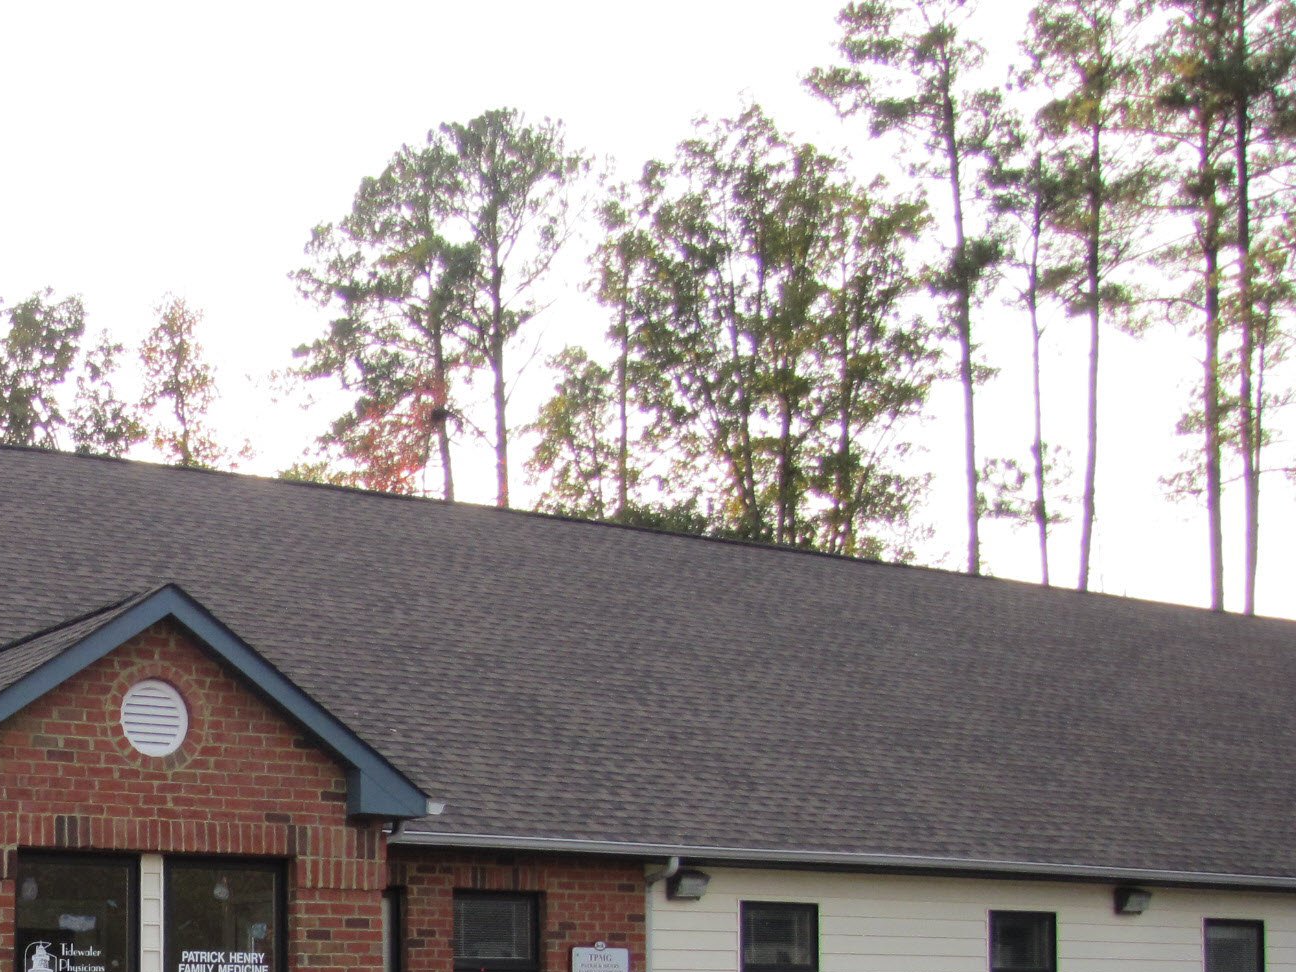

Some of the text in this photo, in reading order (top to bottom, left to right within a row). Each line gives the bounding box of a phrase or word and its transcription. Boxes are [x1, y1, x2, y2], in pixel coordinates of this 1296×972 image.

[60, 943, 101, 957] Tidewater
[182, 951, 265, 964] PATRICK HENRY
